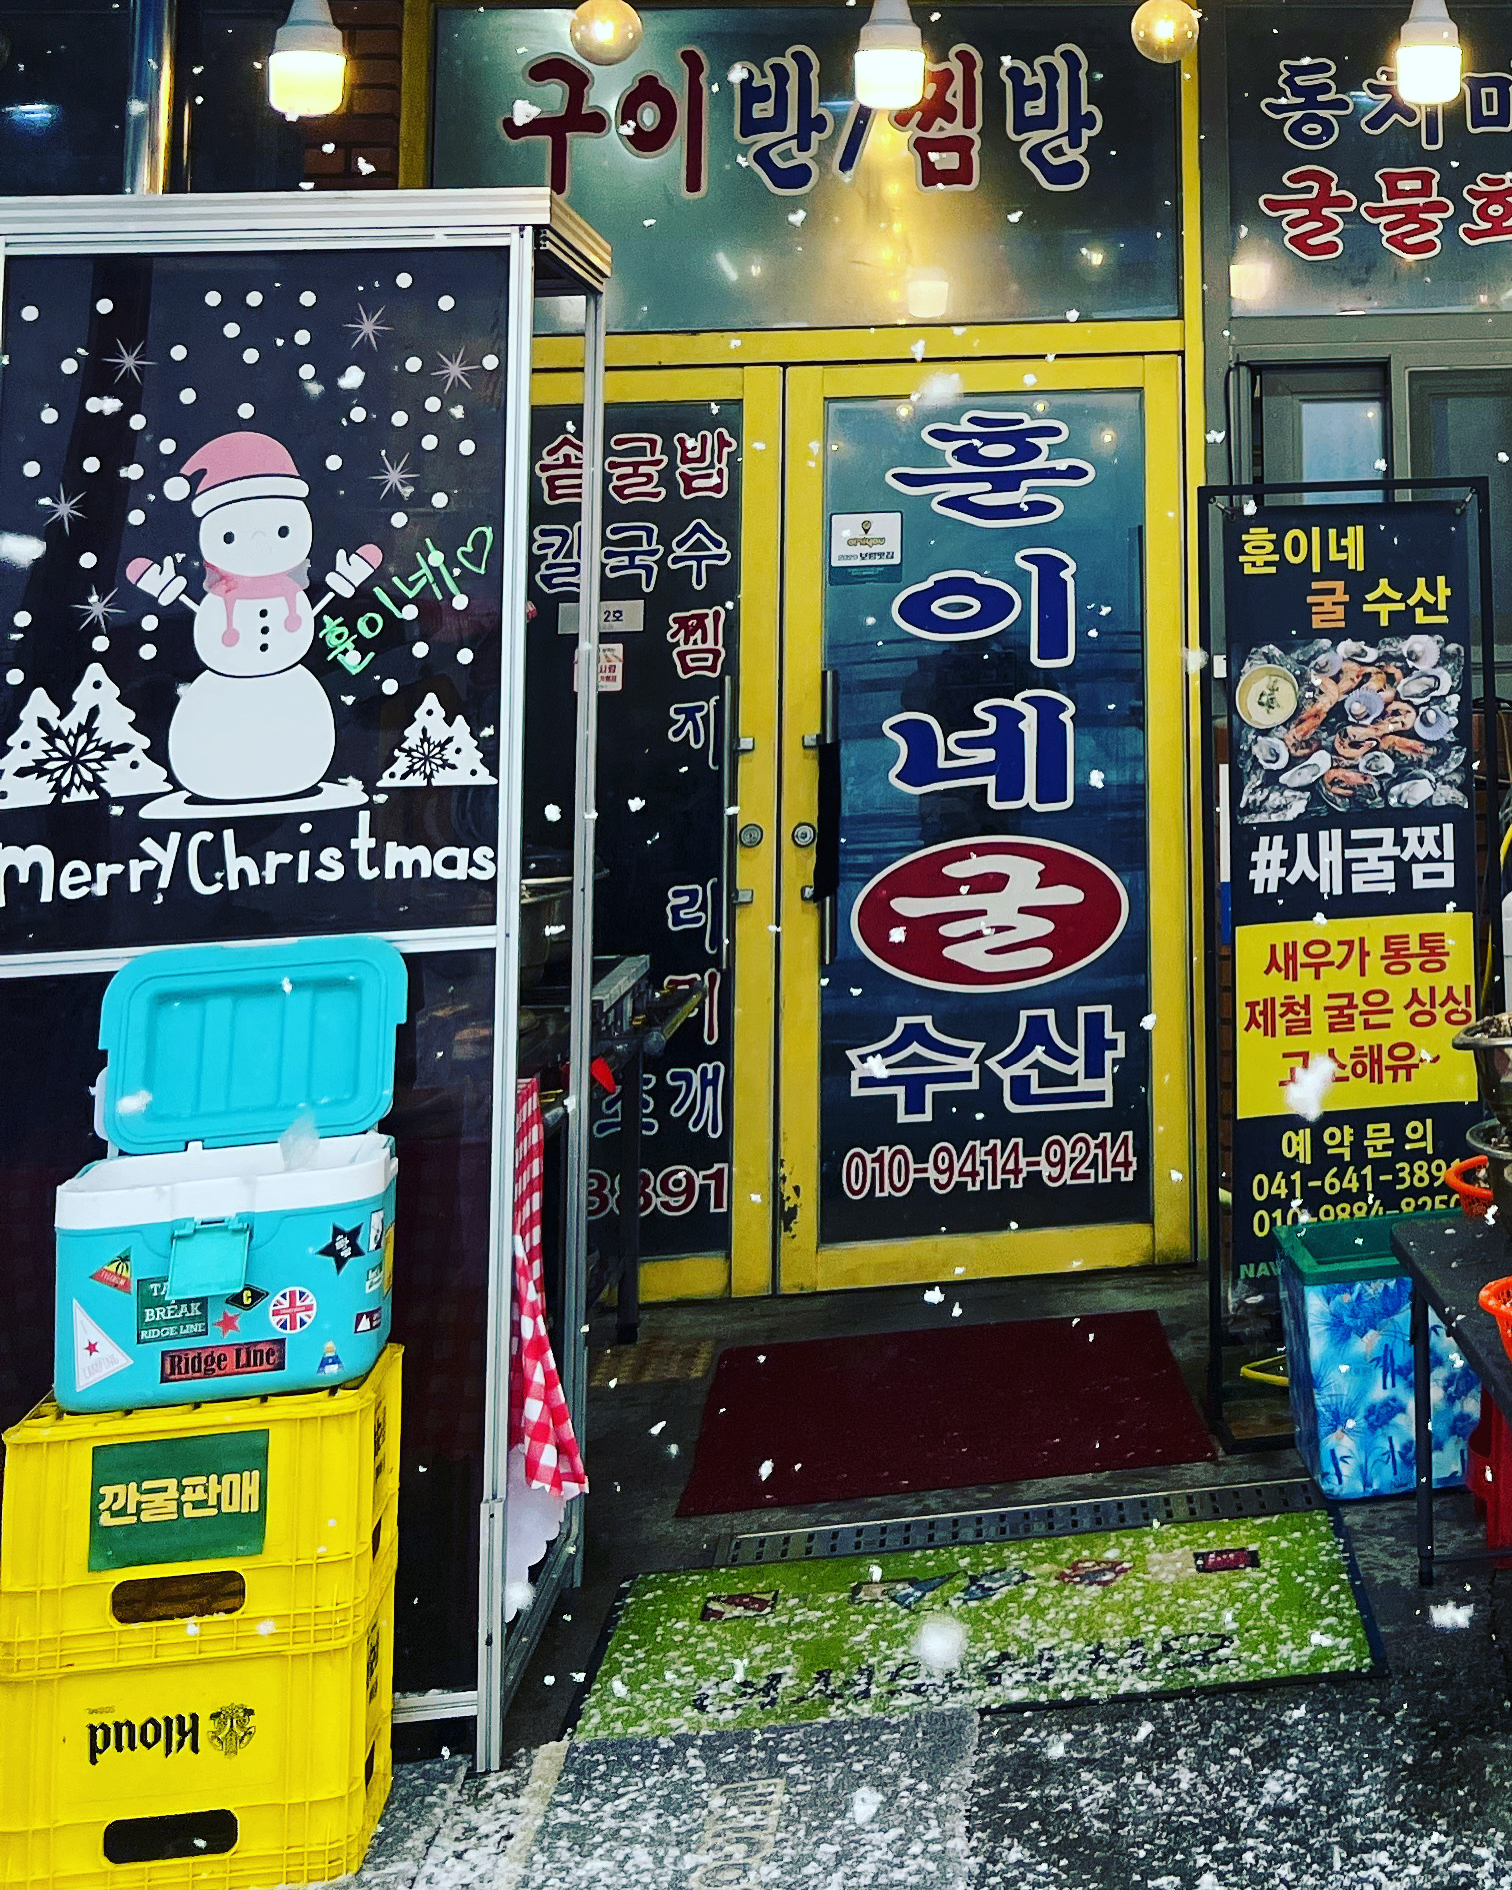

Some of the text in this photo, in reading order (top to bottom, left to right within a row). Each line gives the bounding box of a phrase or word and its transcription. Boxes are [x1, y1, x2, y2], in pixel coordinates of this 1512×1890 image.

[1238, 525, 1365, 574] 훈이네
[1307, 575, 1452, 629] 굴 수산
[187, 808, 498, 896] Christmas
[1249, 823, 1455, 895] #새굴찜
[889, 853, 1085, 973] 굴
[1264, 932, 1450, 982] 새우가 통통
[1244, 984, 1473, 1037] 제철 굴은 싱싱
[845, 1004, 1126, 1123] 수산
[842, 1130, 1137, 1200] 010-9414-9214
[140, 1322, 206, 1340] RIDGE LINE
[144, 1302, 202, 1323] BREAK
[167, 1345, 277, 1376] Ridge Line
[97, 1469, 261, 1528] 깐굴판매
[87, 1712, 200, 1766] Kloud
